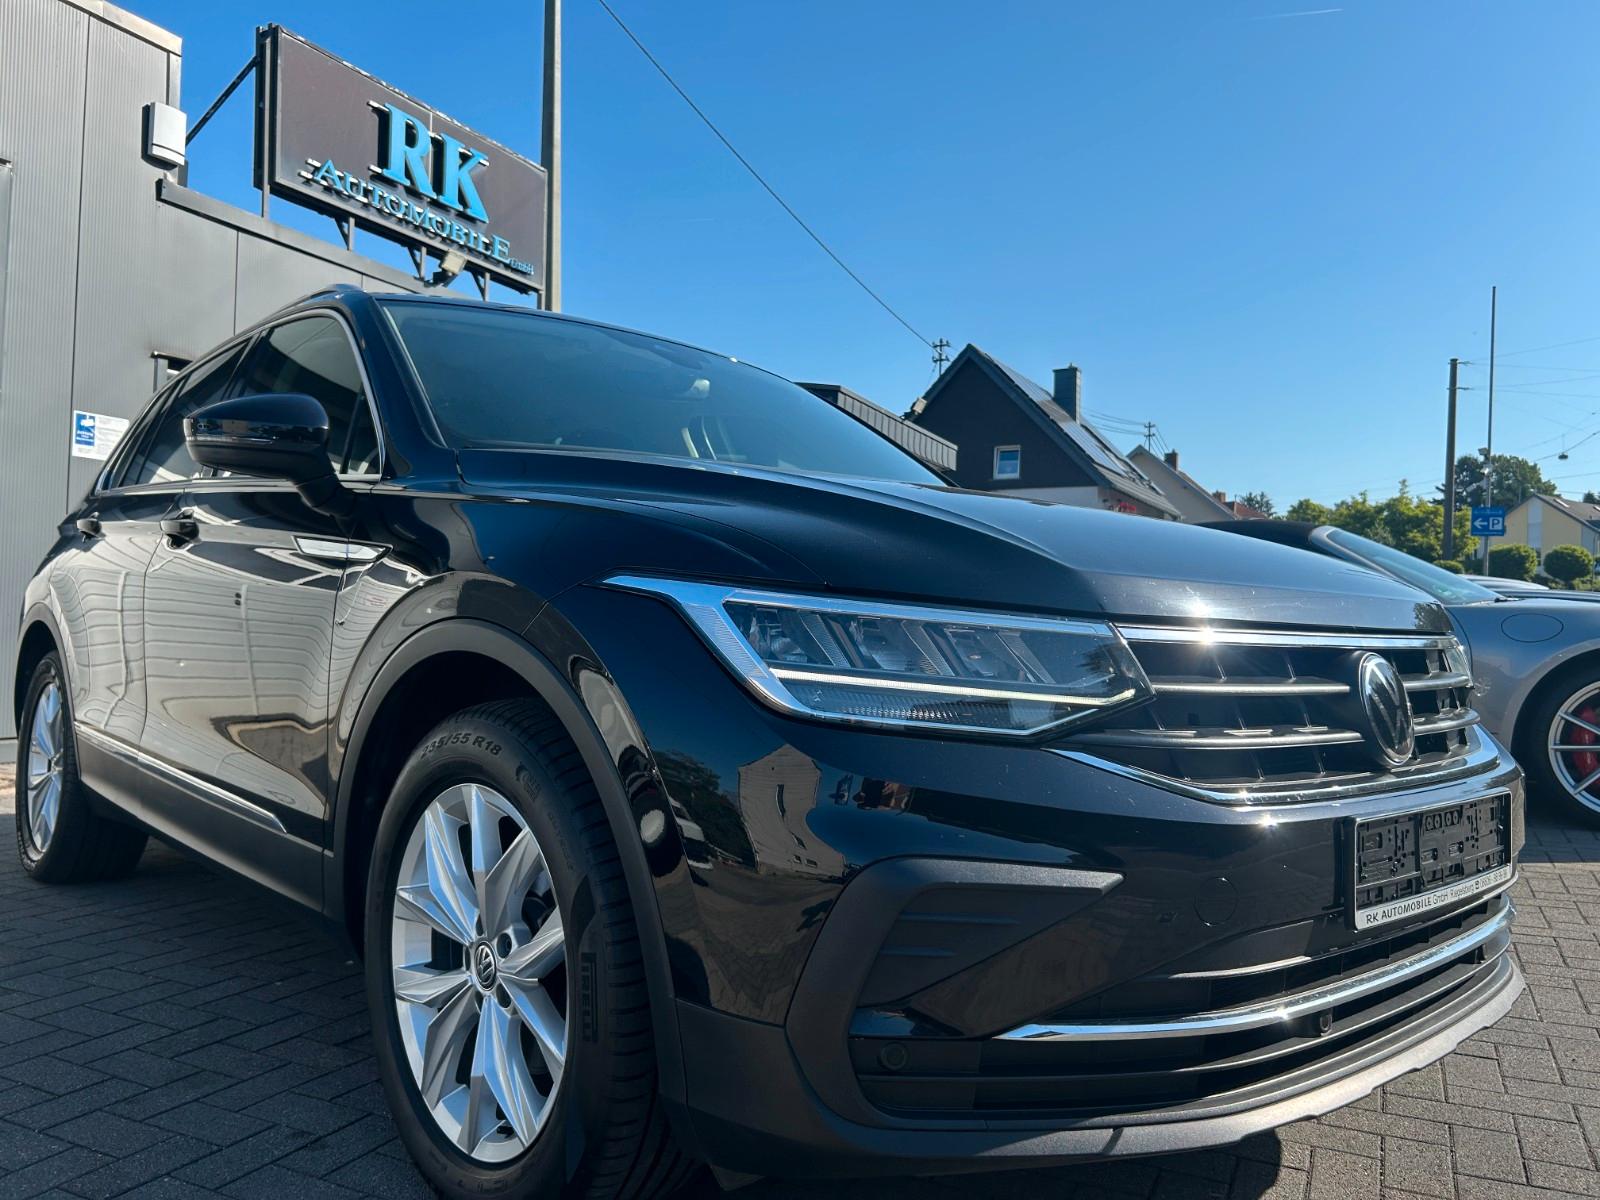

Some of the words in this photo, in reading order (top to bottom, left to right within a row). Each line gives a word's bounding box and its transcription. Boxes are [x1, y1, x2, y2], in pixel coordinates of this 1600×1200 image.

[372, 101, 489, 223] RK
[305, 159, 511, 264] AUTOMOBILE
[420, 732, 472, 760] 235/55
[472, 735, 503, 756] R18
[1365, 911, 1379, 925] RK
[1381, 896, 1432, 920] AUTOMOBILE
